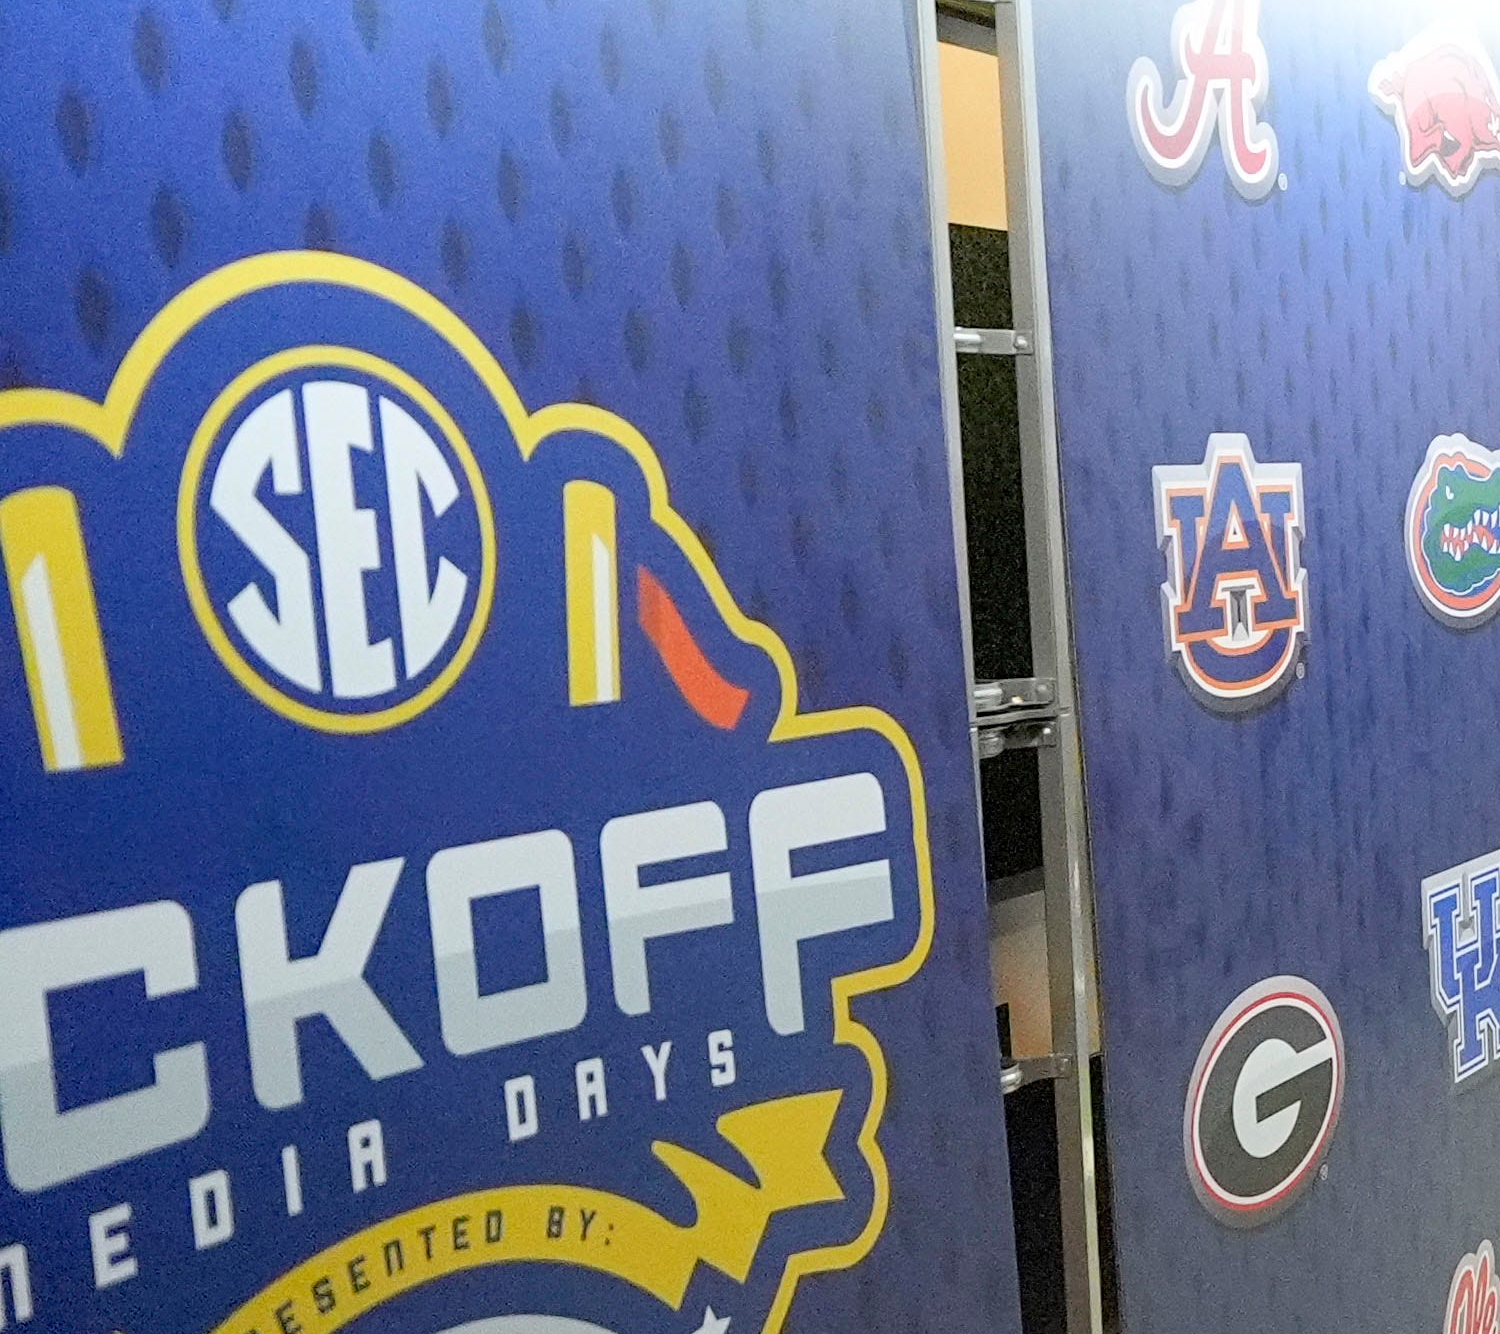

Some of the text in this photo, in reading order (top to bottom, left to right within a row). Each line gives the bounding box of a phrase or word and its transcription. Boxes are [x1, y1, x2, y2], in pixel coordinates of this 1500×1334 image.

[209, 381, 468, 700] SEC
[505, 1029, 738, 1141] DAYS
[546, 1204, 615, 1247] BY:
